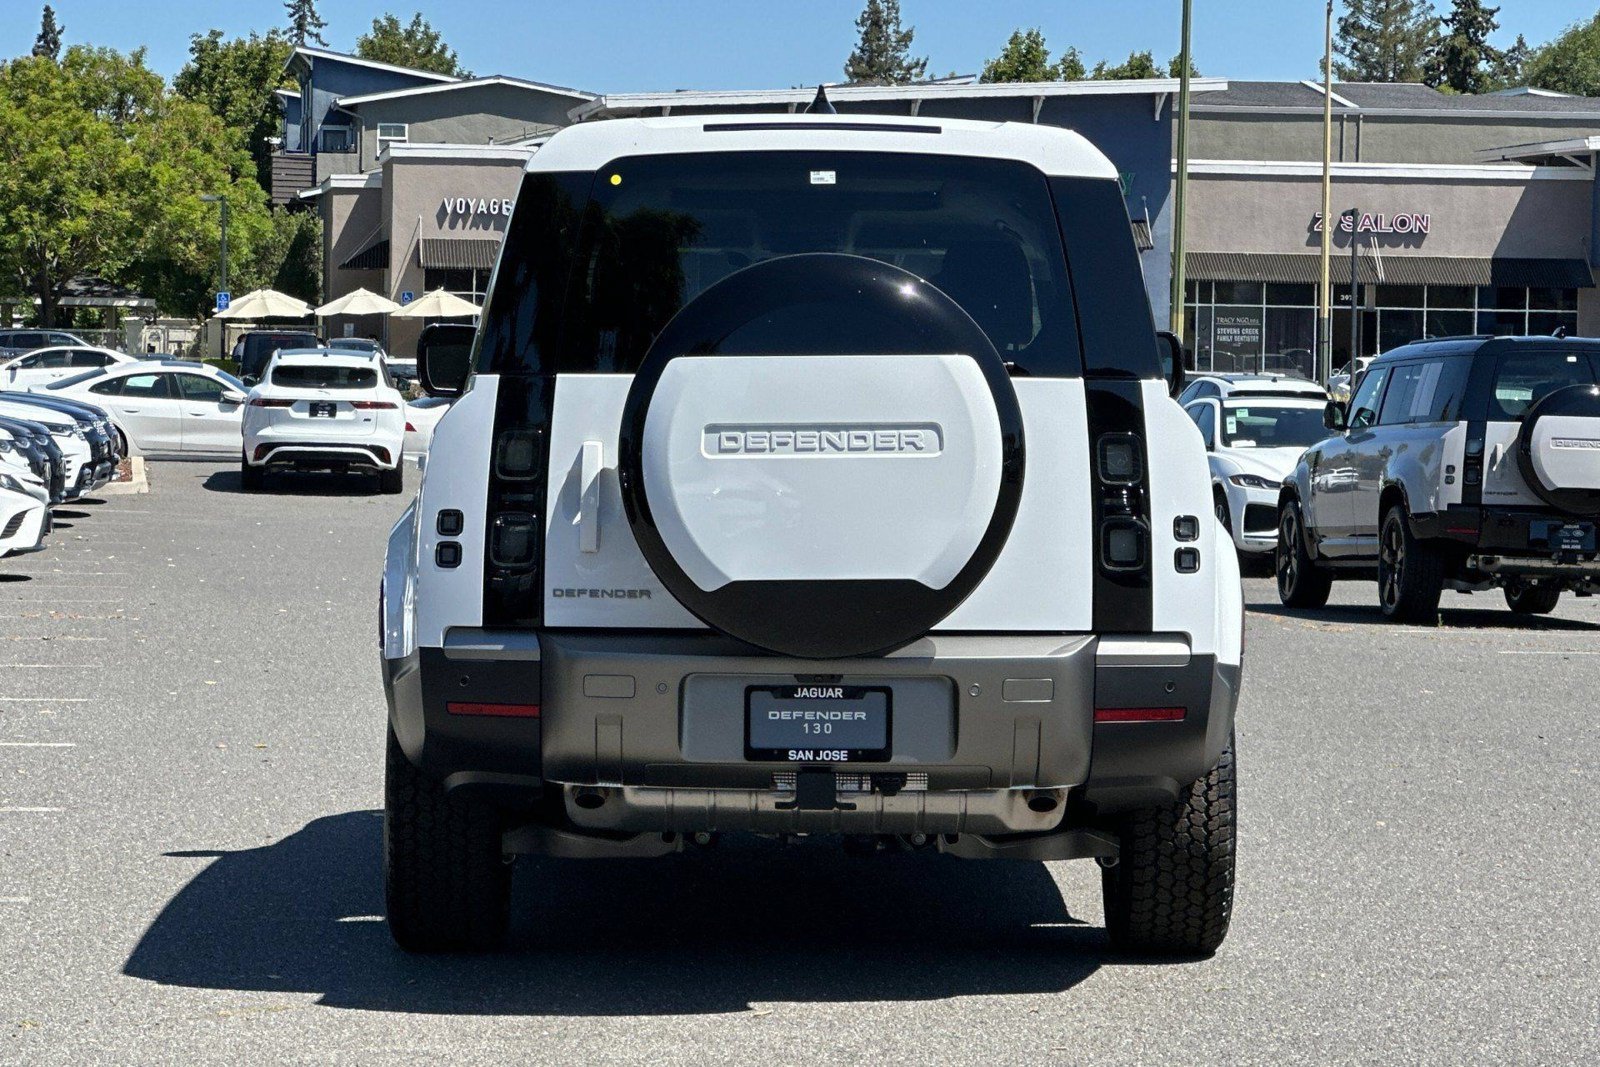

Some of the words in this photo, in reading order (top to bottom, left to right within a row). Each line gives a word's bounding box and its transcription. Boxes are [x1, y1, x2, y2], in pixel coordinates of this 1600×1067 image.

[443, 197, 515, 216] VOYAGE
[1341, 212, 1430, 233] SALON
[718, 431, 925, 452] DEFENDER
[552, 588, 651, 600] DEFENDER
[793, 687, 844, 699] JAGUAR
[768, 711, 867, 720] DEFENDER
[788, 750, 814, 761] SAN
[815, 750, 848, 761] JOSE
